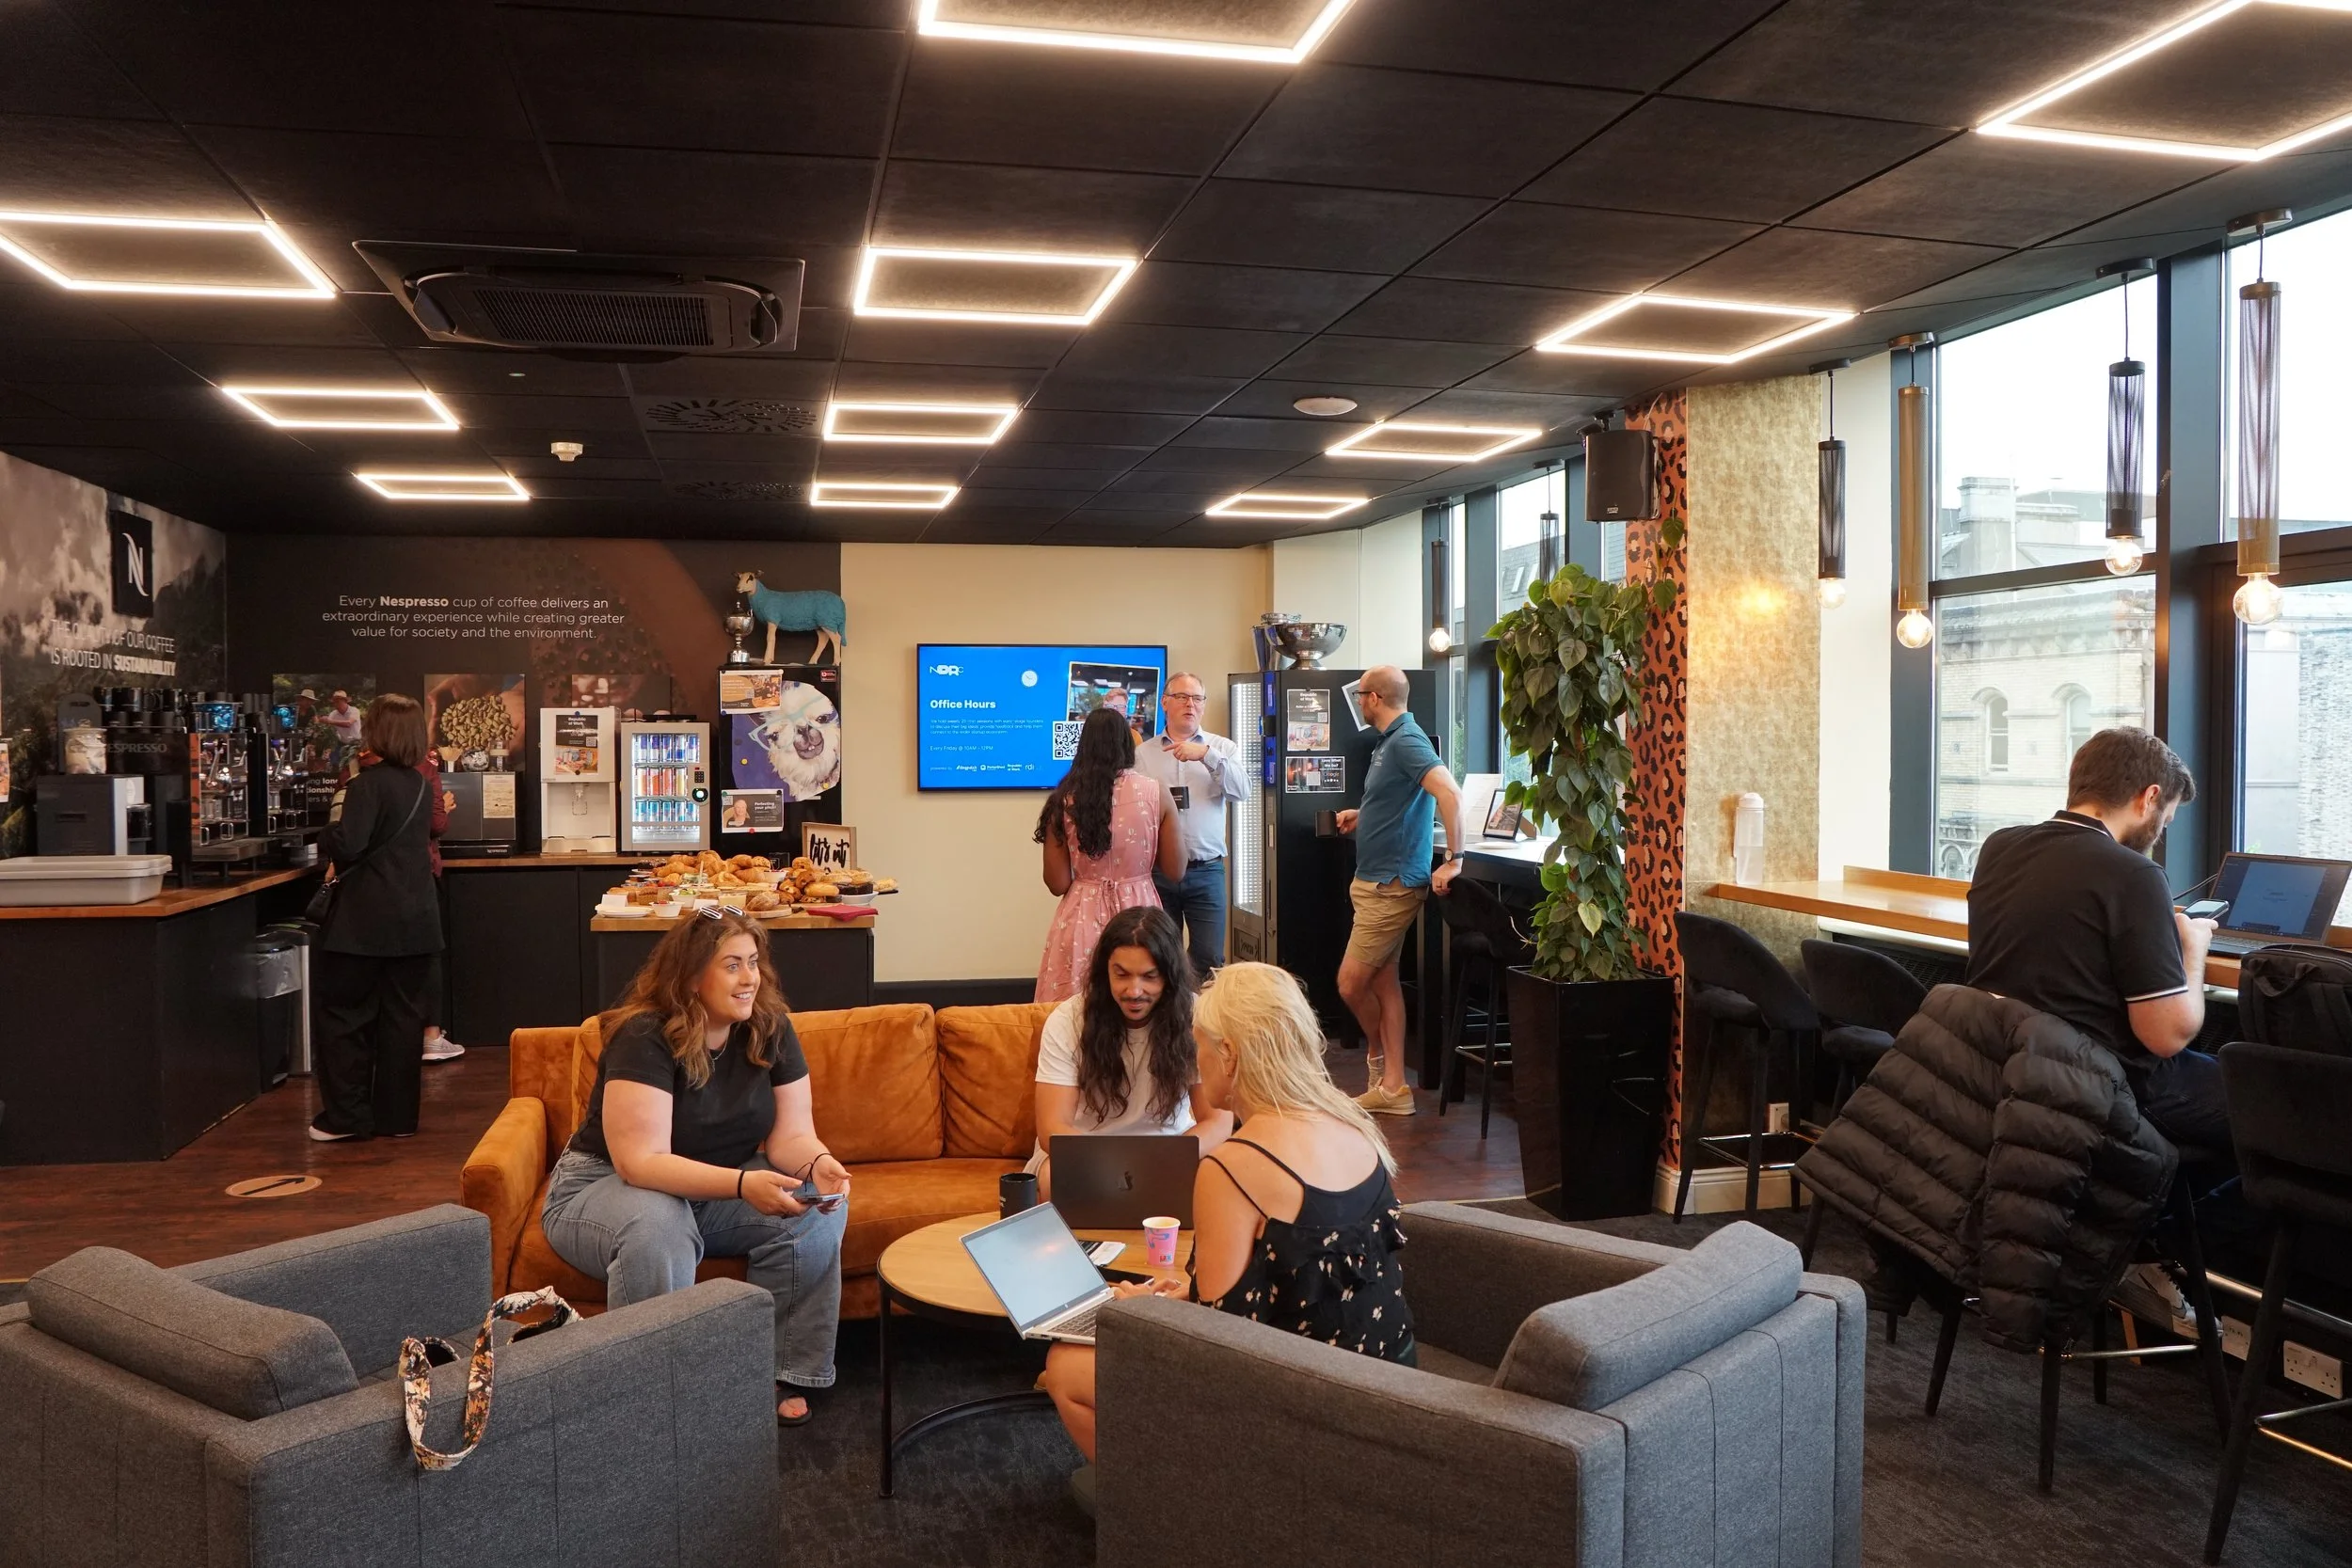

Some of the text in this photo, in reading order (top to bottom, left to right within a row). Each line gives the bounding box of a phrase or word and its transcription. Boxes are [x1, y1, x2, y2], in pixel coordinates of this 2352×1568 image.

[122, 532, 150, 596] N
[340, 595, 609, 609] Every Nespresso cup of coffee delivers an
[322, 611, 625, 626] extraordinary experience while creating greater
[352, 626, 597, 639] value for society and the environment.
[113, 631, 125, 646] OF
[127, 631, 145, 649] OUR
[146, 635, 176, 654] COFFEE
[51, 647, 177, 676] IS ROOTED IN SUSTAINABILITY
[930, 699, 996, 709] Office Hours
[107, 743, 167, 753] ESPRESSO
